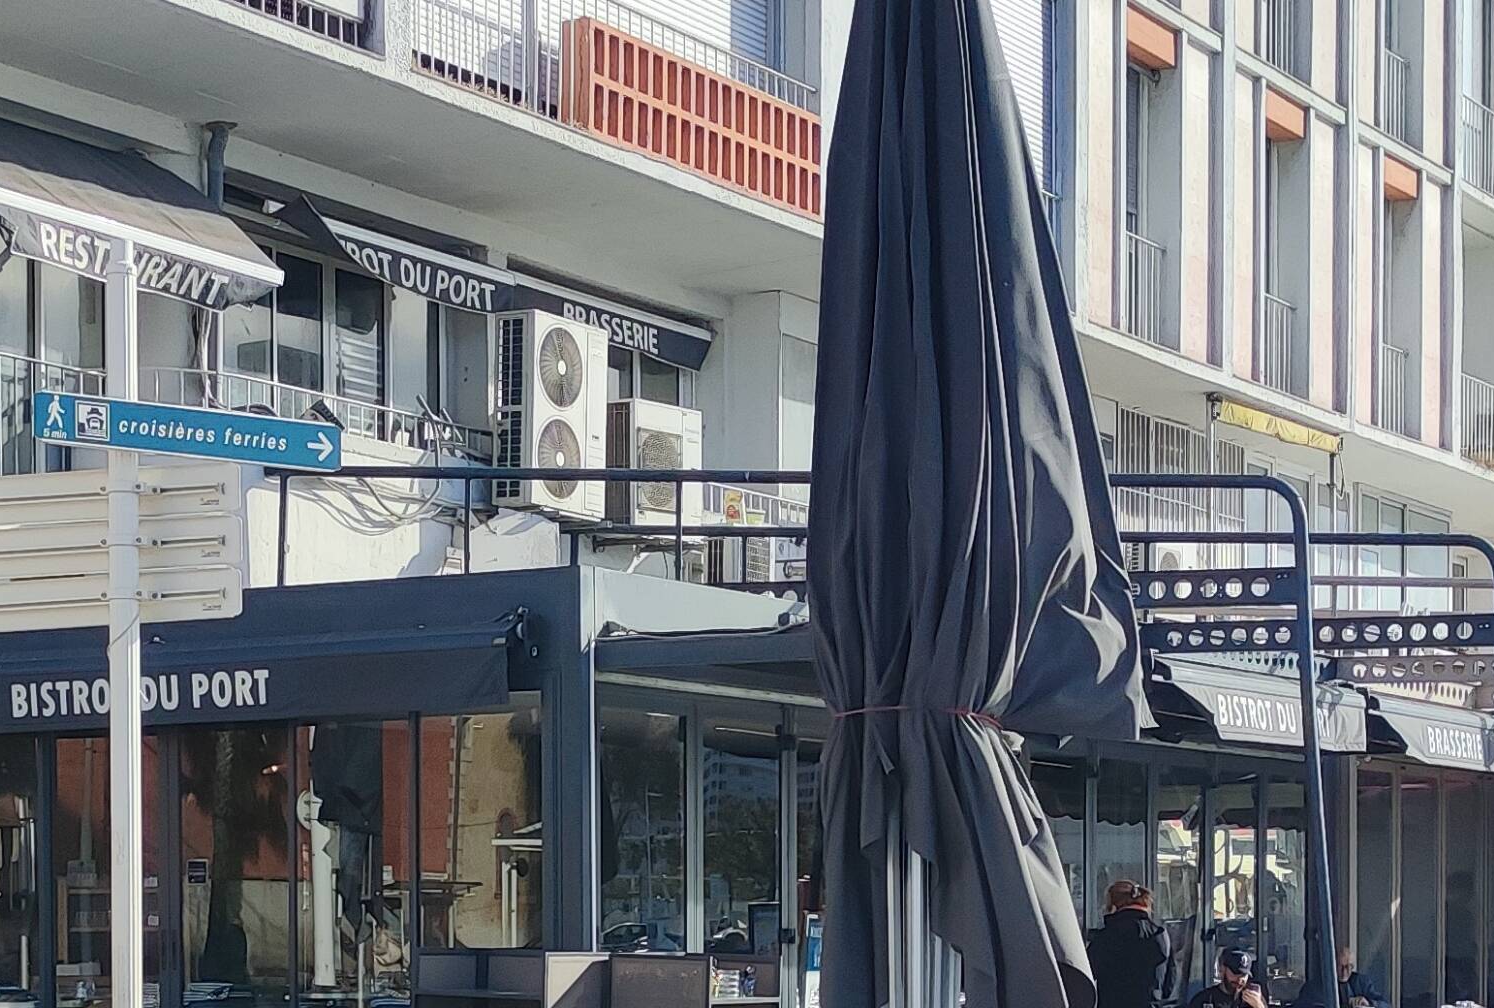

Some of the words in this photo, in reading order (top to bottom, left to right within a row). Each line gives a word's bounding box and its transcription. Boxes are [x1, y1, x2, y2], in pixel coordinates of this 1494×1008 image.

[39, 222, 230, 305] RESTRANT
[400, 258, 431, 295] DU
[435, 270, 496, 312] PORT
[563, 302, 659, 355] BRASSERIE
[43, 428, 50, 438] 5
[51, 429, 67, 439] min
[118, 418, 215, 443] croisières
[224, 427, 288, 451] ferries
[10, 678, 111, 718] BISTRO
[140, 674, 180, 712] DU
[191, 669, 270, 709] PORT
[1217, 694, 1274, 732] BISTROT
[1277, 701, 1297, 734] DU
[1427, 725, 1483, 760] BRASSERIE
